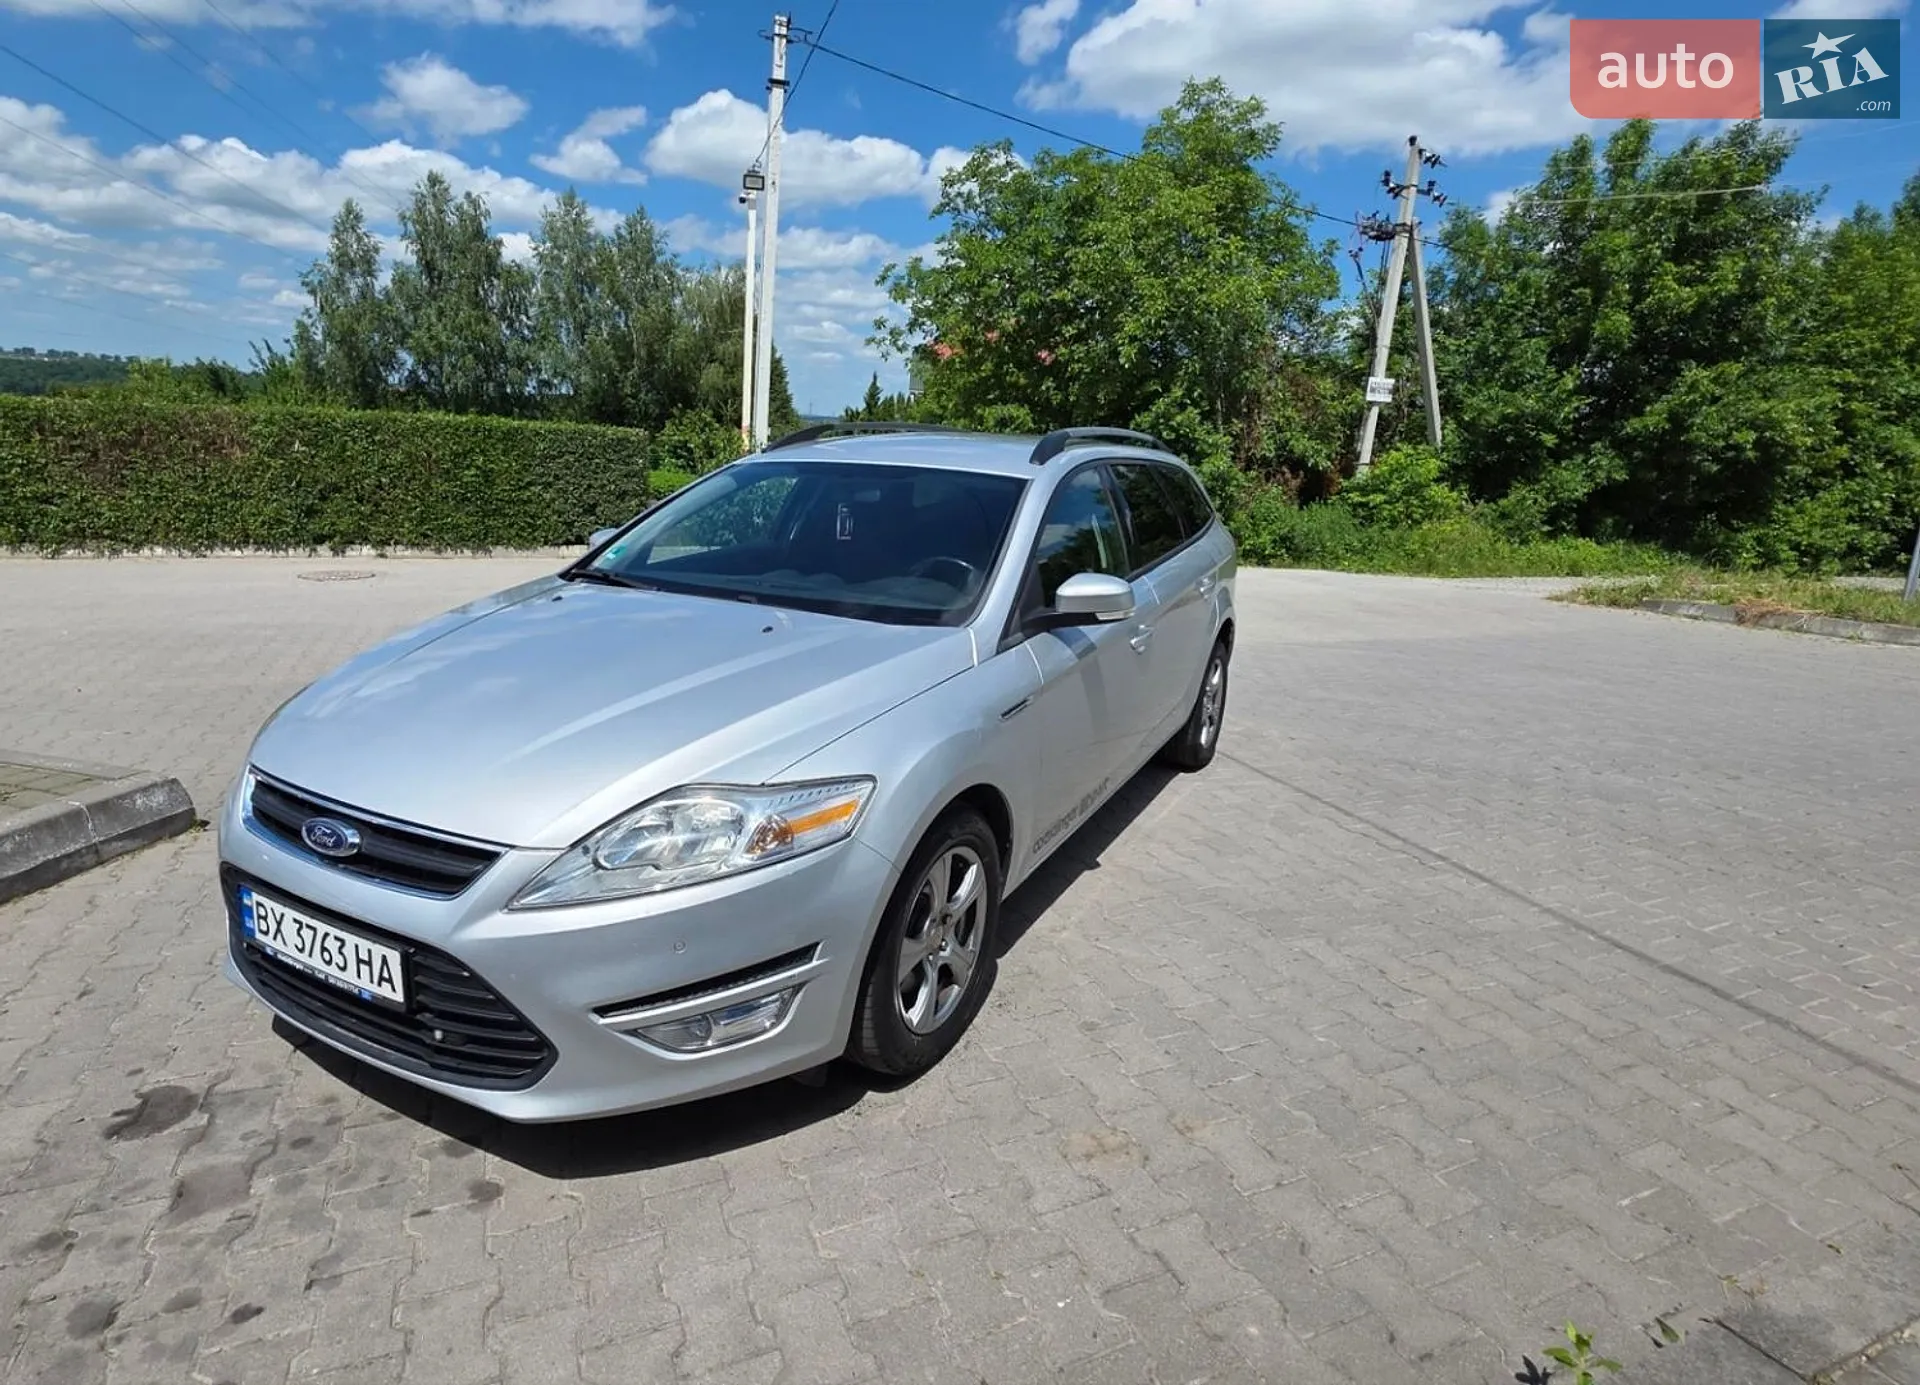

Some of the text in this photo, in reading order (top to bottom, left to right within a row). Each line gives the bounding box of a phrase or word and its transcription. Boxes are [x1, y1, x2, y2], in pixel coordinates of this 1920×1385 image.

[310, 825, 337, 847] Ford
[255, 900, 288, 947] BX
[294, 918, 348, 972] 3763
[354, 943, 397, 994] HA
